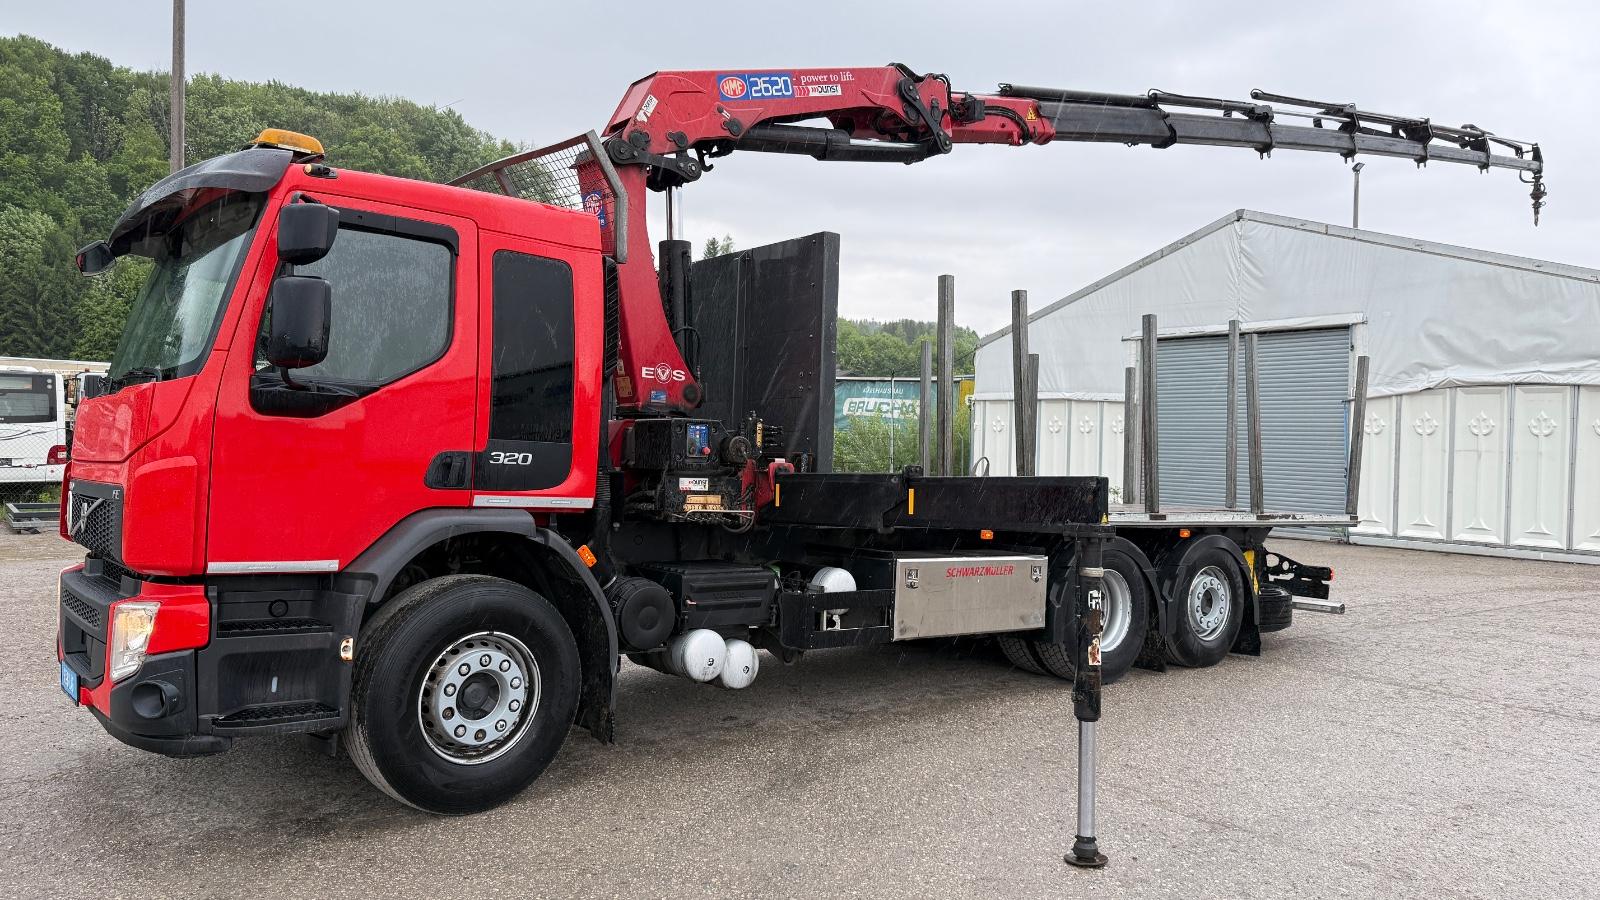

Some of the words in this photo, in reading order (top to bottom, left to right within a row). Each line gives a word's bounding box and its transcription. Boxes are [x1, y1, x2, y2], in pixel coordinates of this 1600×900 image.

[801, 74, 828, 85] power
[830, 73, 838, 82] to
[723, 79, 743, 96] HMF
[750, 77, 792, 97] 2620
[489, 451, 533, 465] 320
[946, 565, 1015, 578] SCHWARZMÜLLER
